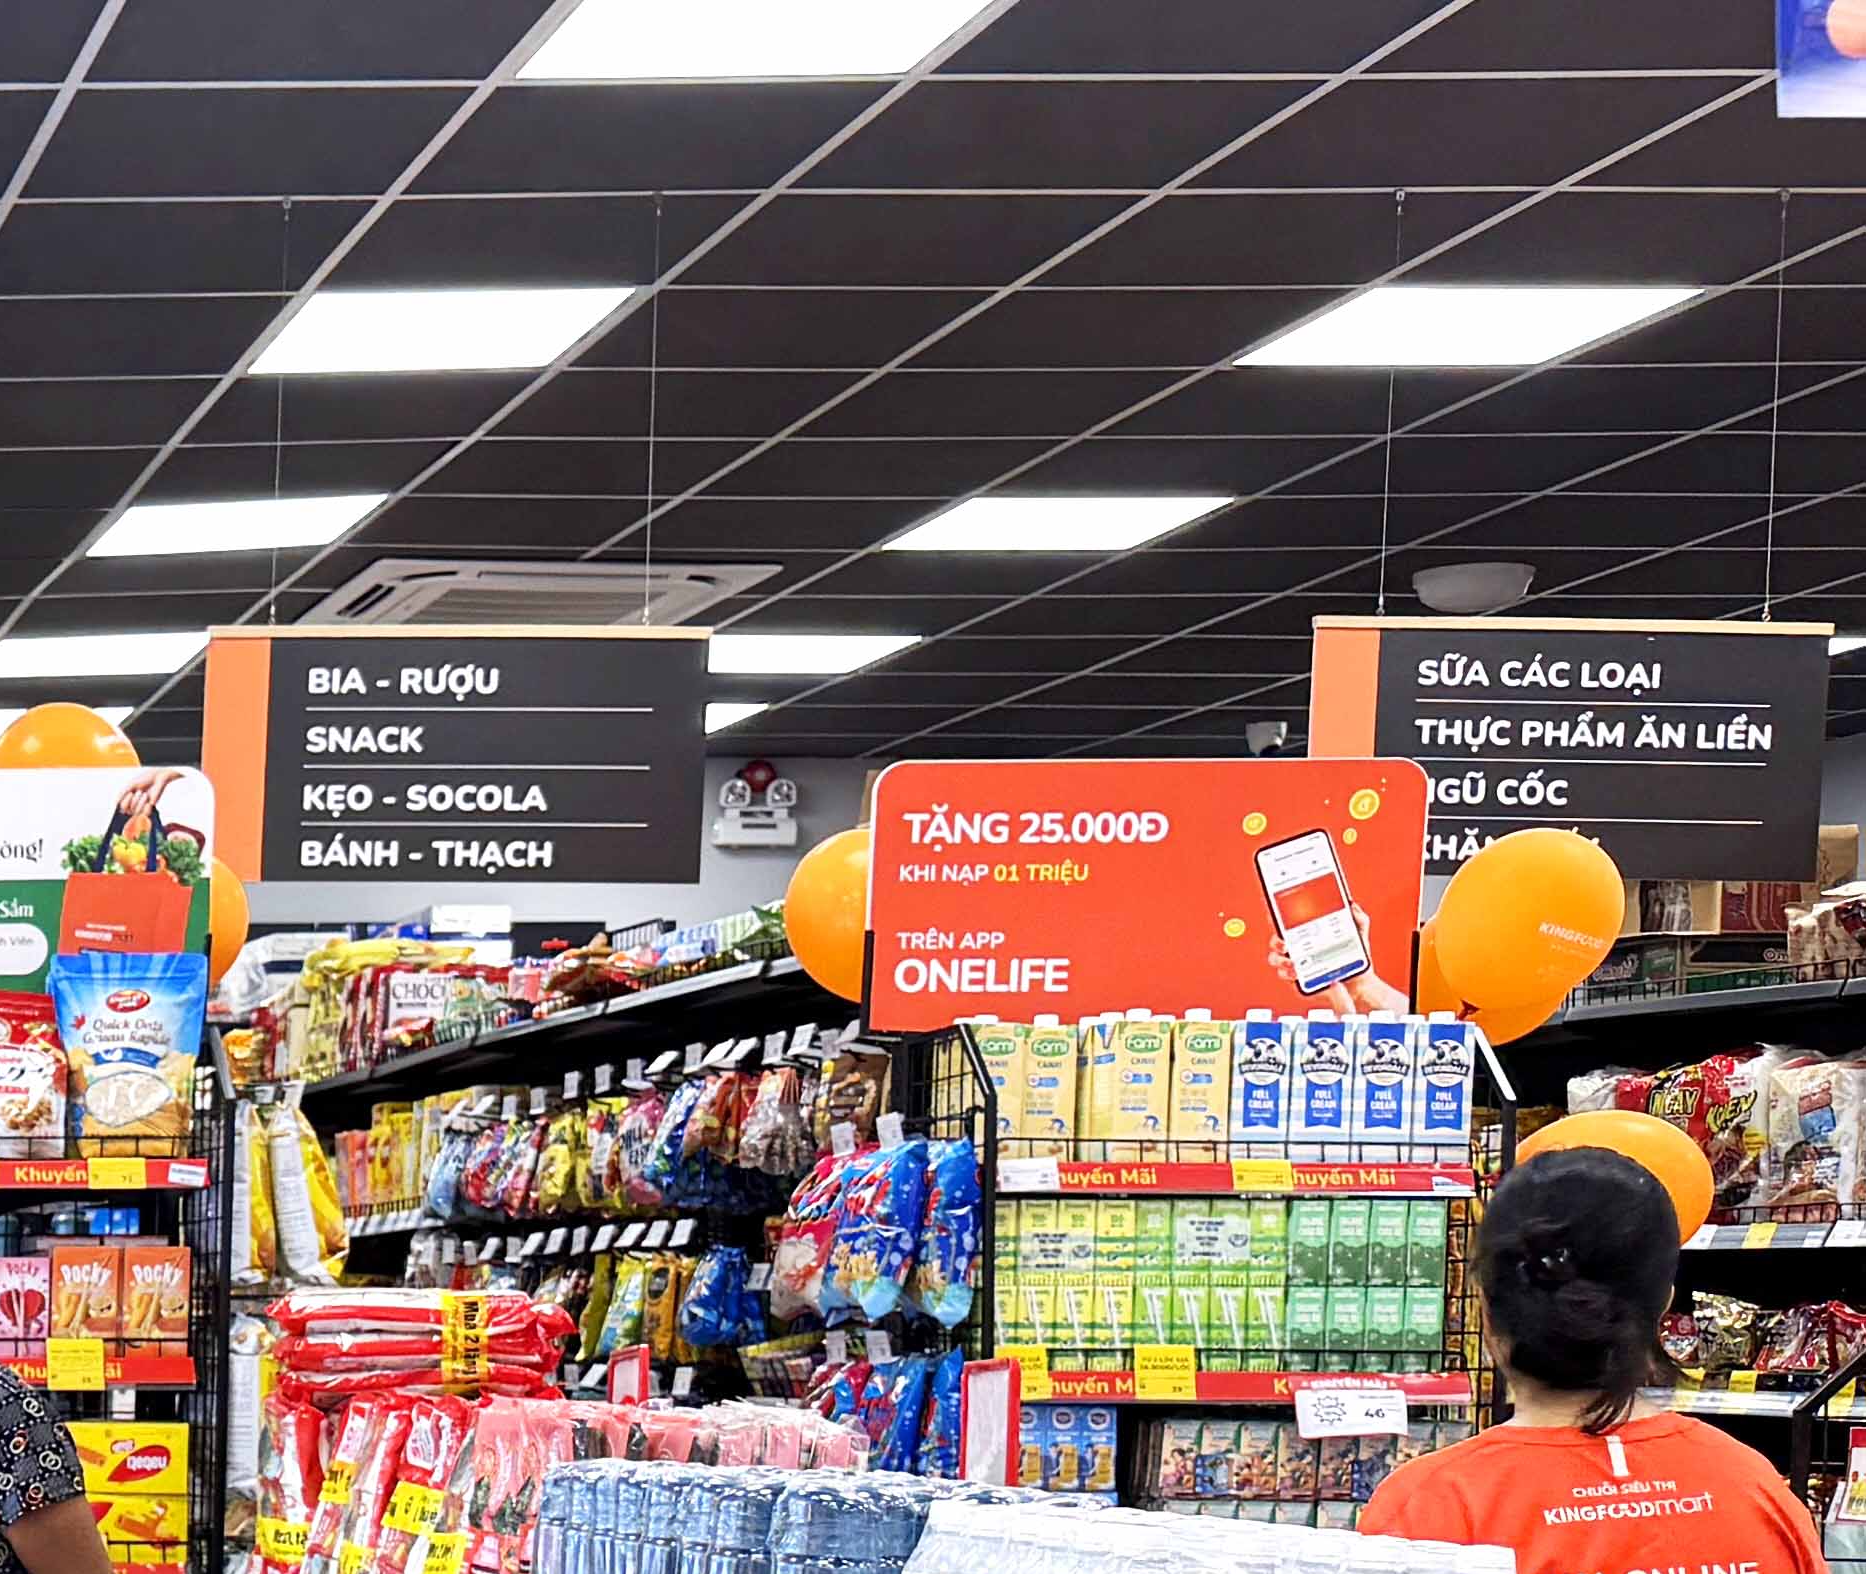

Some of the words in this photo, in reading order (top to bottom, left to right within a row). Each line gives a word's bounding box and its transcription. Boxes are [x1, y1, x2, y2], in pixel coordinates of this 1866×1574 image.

[307, 667, 366, 694] BIA
[400, 663, 499, 701] RƯỢU
[1417, 653, 1490, 687] SỮA
[1500, 654, 1570, 688] CÁC
[1580, 662, 1661, 695] LOẠI
[306, 726, 424, 753] SNACK
[1415, 716, 1511, 752] THỰC
[1522, 711, 1624, 749] PHẨM
[1634, 713, 1686, 749] ĂN
[1697, 714, 1772, 751] LIỀN
[302, 784, 372, 817] KẸO
[406, 784, 547, 812] SOCOLA
[1427, 770, 1486, 804] GŨ
[1496, 768, 1568, 805] CỐC
[903, 804, 1010, 852] TẶNG
[1018, 811, 1169, 844] 25.000Đ
[300, 833, 398, 867] BÁNH
[432, 841, 553, 875] THẠCH
[898, 864, 936, 882] KHI
[941, 864, 989, 887] NẠP
[993, 864, 1020, 882] 01
[1026, 859, 1089, 887] TRIỆU
[896, 928, 954, 951] TRÊN
[959, 931, 1005, 950] APP
[894, 957, 1070, 994] ONELIFE
[15, 1162, 88, 1187] Khuyến
[1120, 1166, 1158, 1186] Mãi
[1293, 1168, 1354, 1189] huyến
[1359, 1167, 1396, 1186] Mãi
[8, 1363, 49, 1380] Khu
[1543, 1491, 1714, 1526] KINGFOODmart
